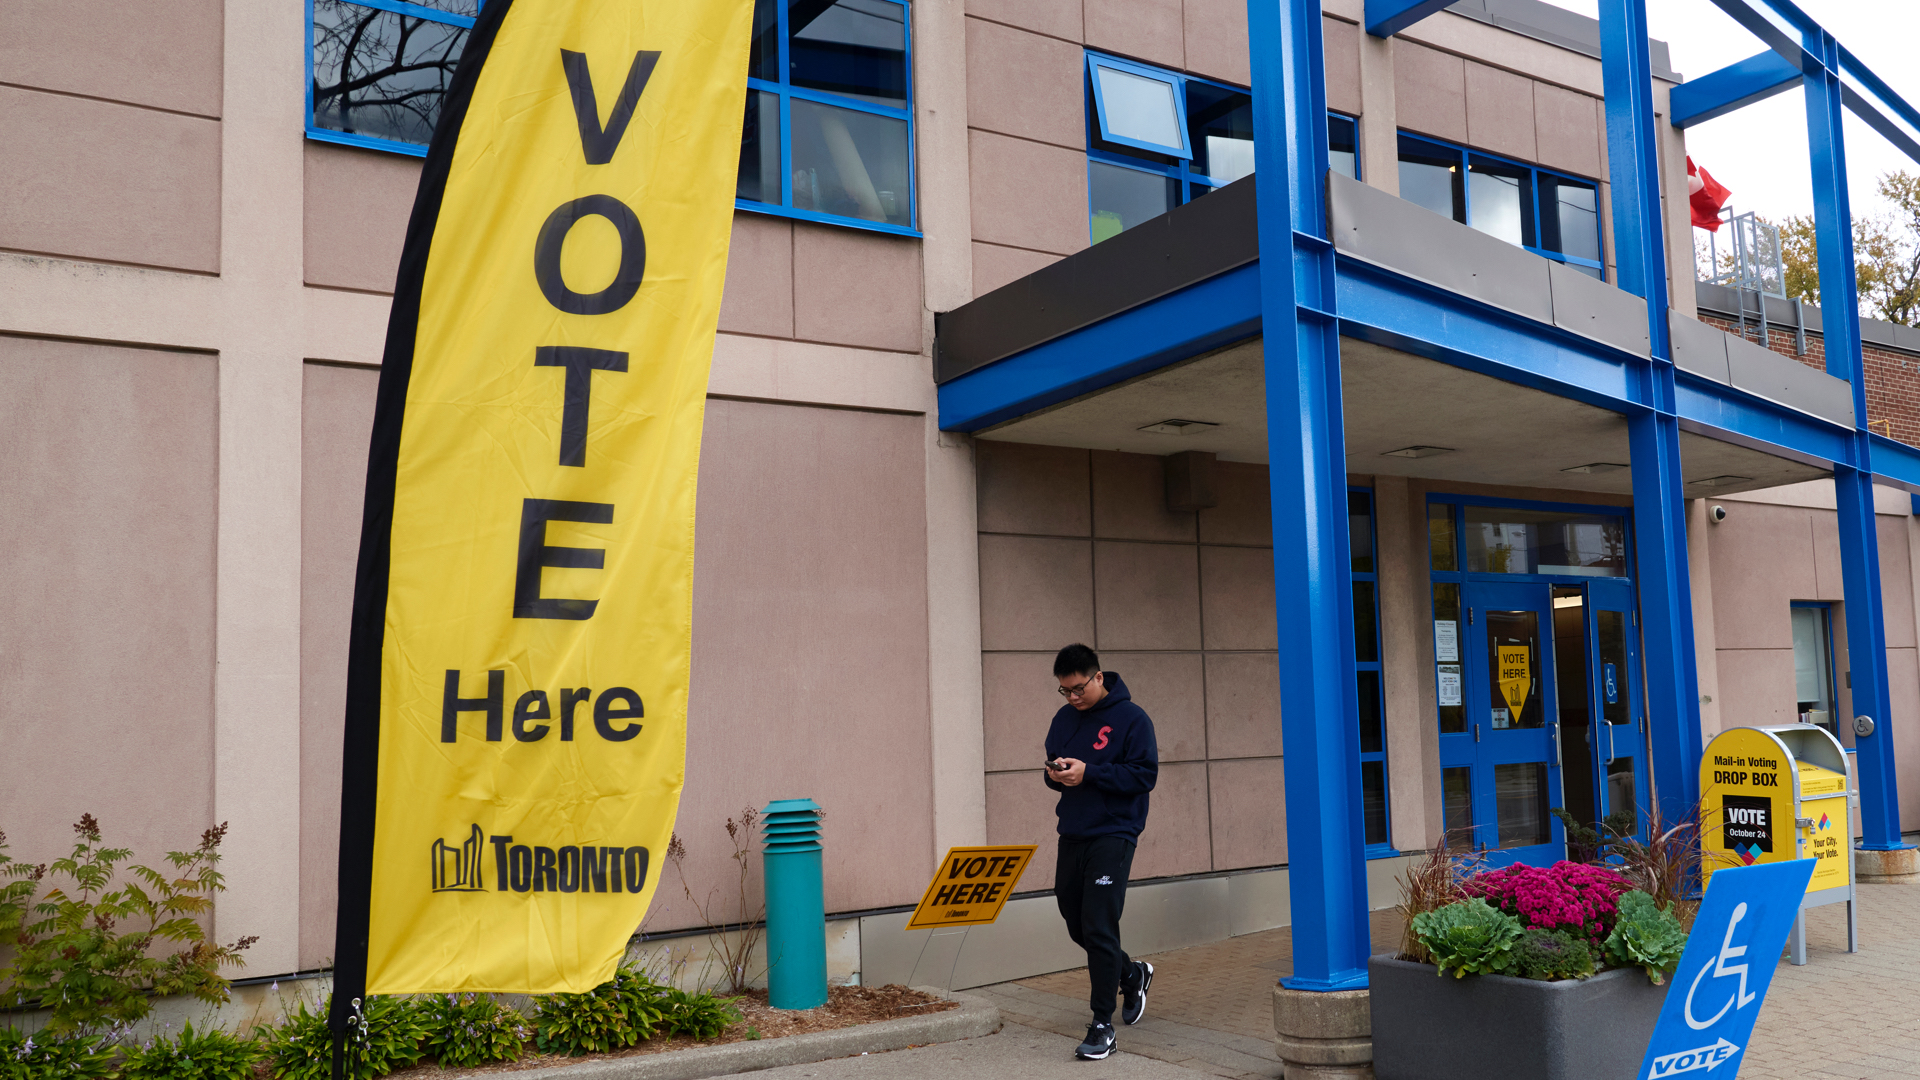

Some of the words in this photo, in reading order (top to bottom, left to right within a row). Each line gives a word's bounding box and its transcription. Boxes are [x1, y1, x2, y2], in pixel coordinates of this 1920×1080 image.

[512, 47, 662, 620] VOTE
[1503, 654, 1524, 663] VOTE
[1503, 669, 1526, 678] HERE
[441, 669, 644, 743] Here
[1093, 726, 1113, 750] S
[1715, 756, 1745, 766] Mail-in
[1748, 757, 1777, 770] Voting
[1714, 771, 1747, 784] DROP
[1752, 772, 1778, 786] BOX
[1728, 808, 1766, 826] VOTE
[1730, 828, 1755, 837] October
[1813, 839, 1825, 848] Your
[1826, 836, 1837, 846] City.
[1813, 851, 1824, 859] Your
[1826, 849, 1838, 858] Vote.
[948, 856, 1021, 879] VOTE
[931, 882, 1006, 906] HERE
[1654, 1045, 1730, 1075] VOTE
